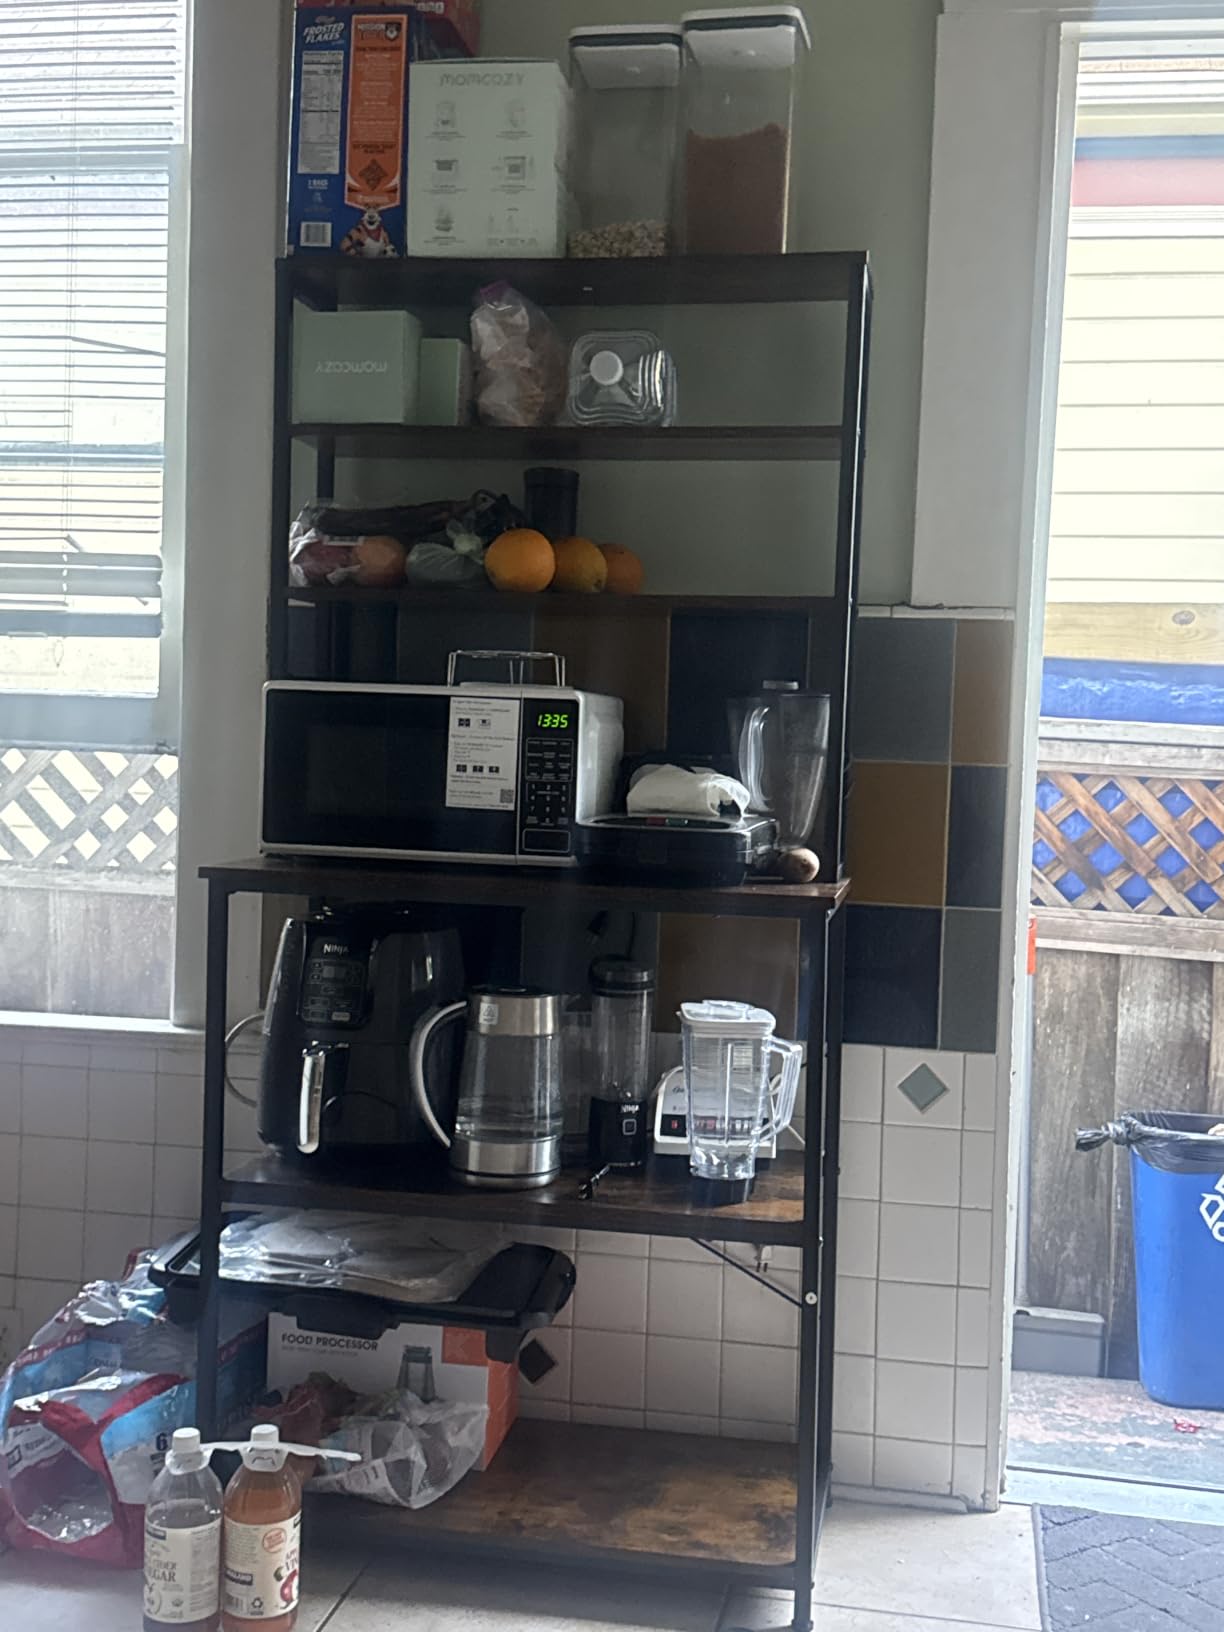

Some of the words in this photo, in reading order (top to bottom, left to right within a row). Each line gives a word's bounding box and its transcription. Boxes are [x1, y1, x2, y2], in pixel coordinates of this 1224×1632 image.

[303, 22, 345, 37] FROSTED
[305, 31, 340, 44] FLAKES
[281, 1333, 313, 1345] FOOD
[315, 1336, 378, 1351] PROCESSOR
